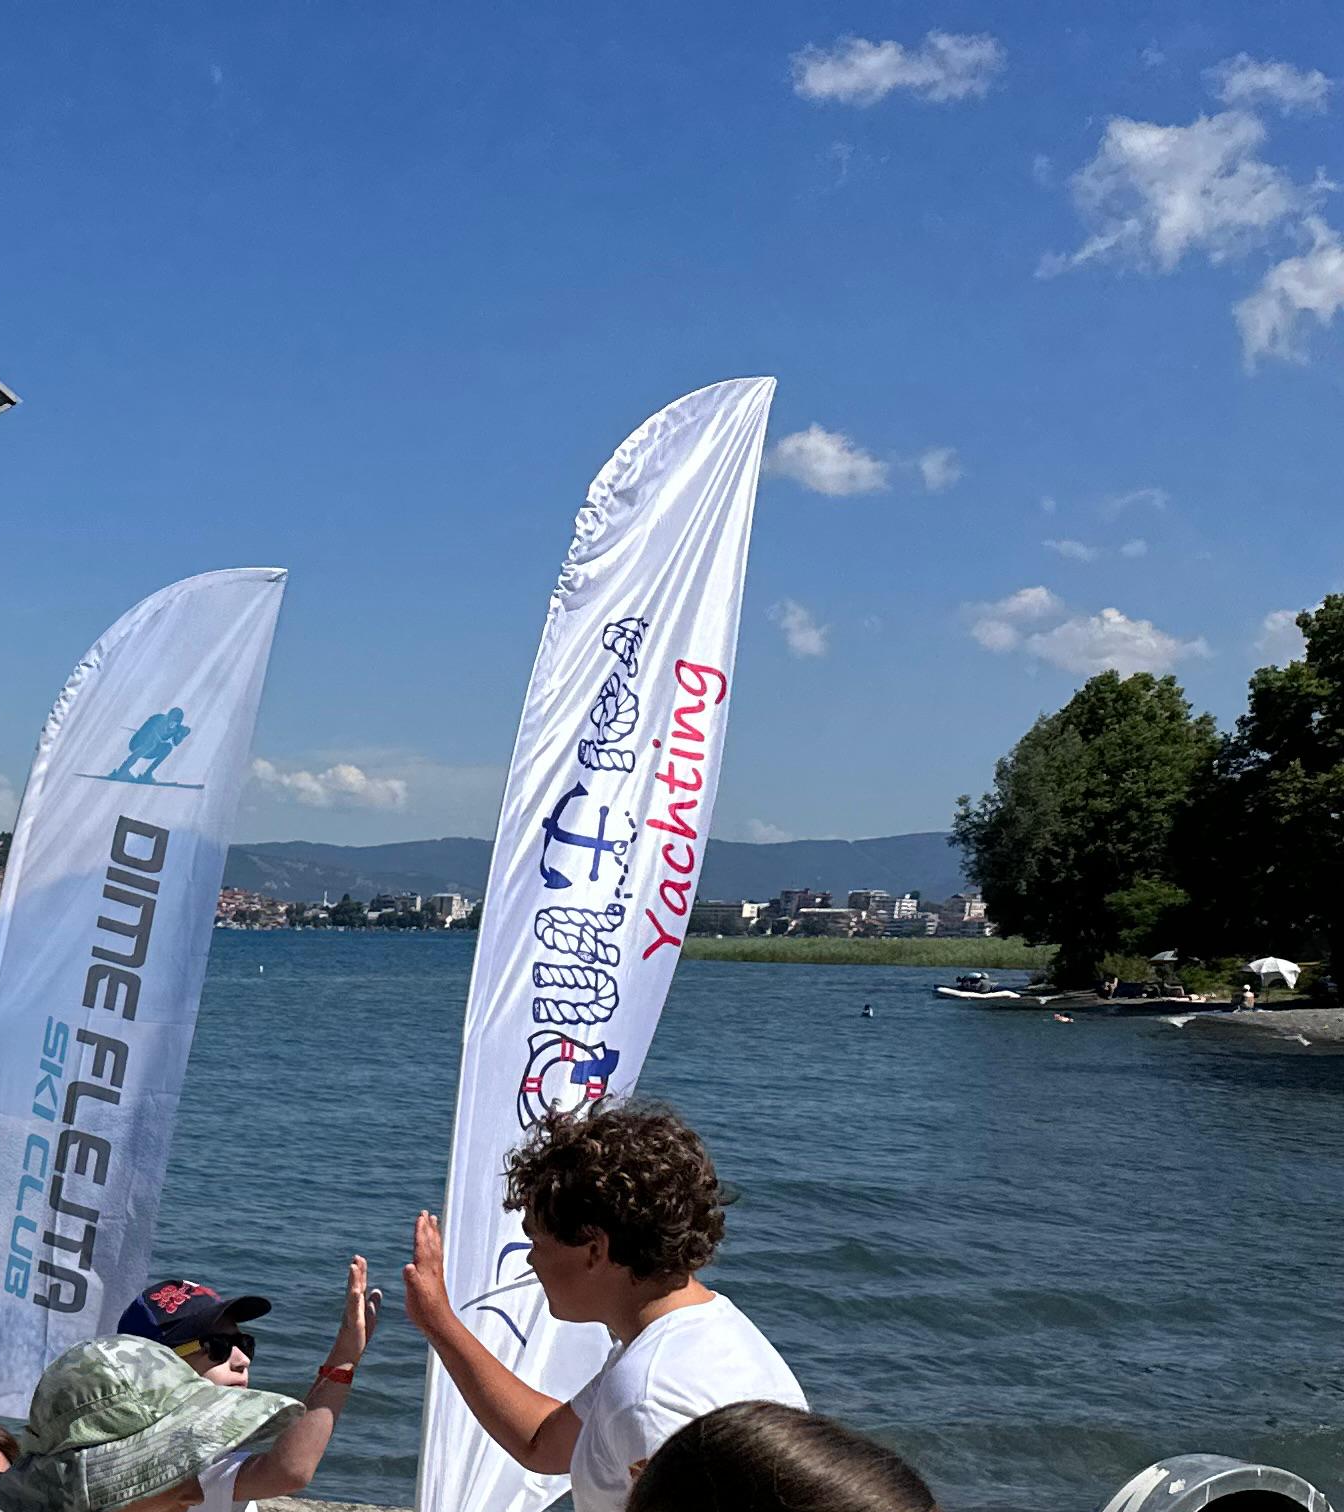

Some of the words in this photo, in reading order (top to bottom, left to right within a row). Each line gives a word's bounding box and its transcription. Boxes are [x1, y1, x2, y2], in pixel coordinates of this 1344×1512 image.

[642, 658, 727, 961] Yachting
[82, 814, 170, 1022] DIME
[32, 1015, 69, 1122] SKI
[33, 1027, 129, 1314] FLEJTA
[4, 1133, 50, 1300] CLUB
